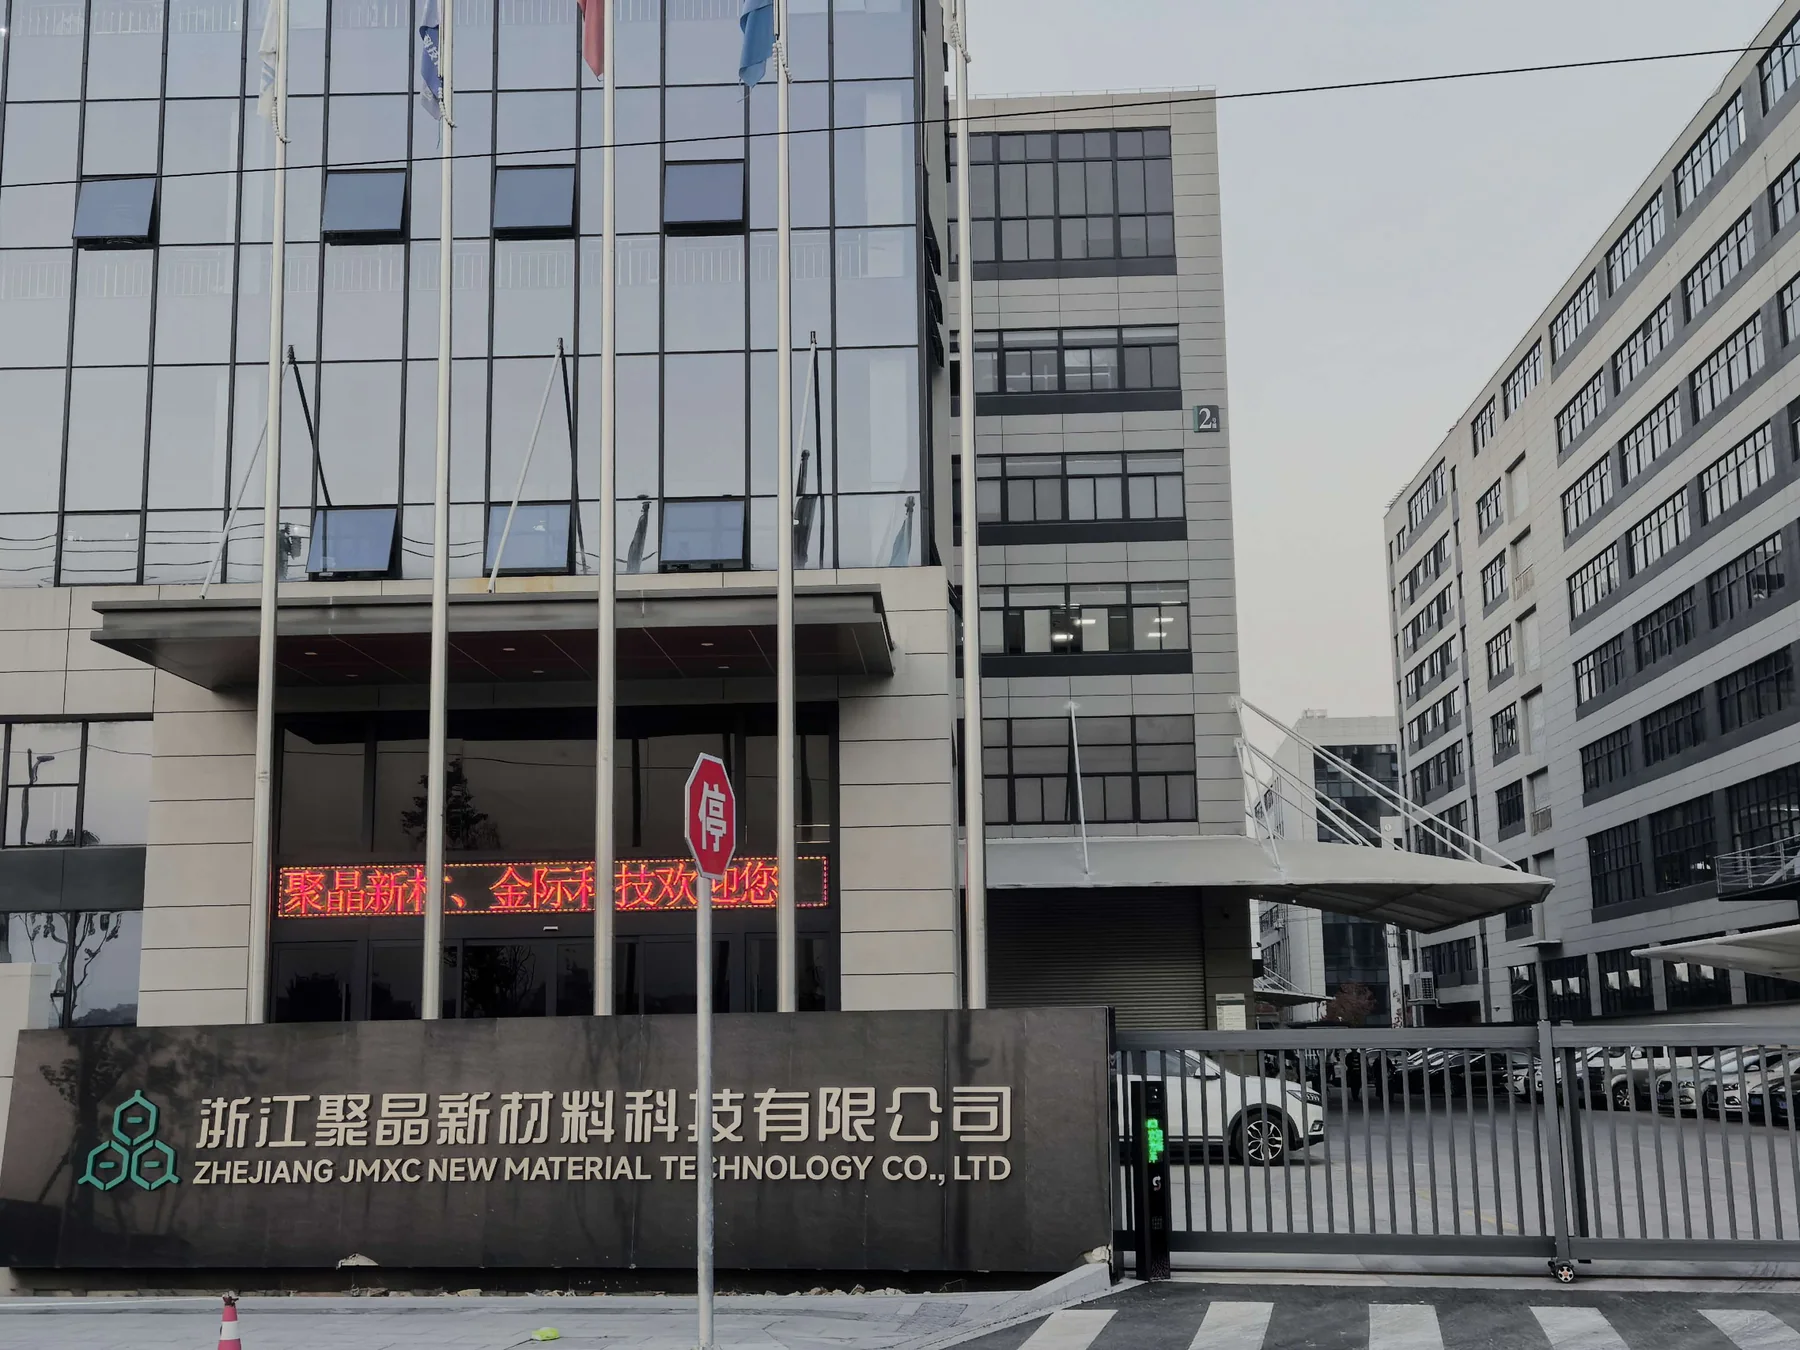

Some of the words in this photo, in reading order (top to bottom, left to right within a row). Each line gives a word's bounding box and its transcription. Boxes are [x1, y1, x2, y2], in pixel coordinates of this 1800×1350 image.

[698, 780, 727, 852] 停
[195, 1086, 1012, 1149] 浙江聚晶新材料科技有限公司
[192, 1160, 334, 1185] ZHEJIANG
[340, 1158, 423, 1183] JMXC
[428, 1157, 498, 1182] NEW
[504, 1155, 651, 1182] MATERIAL
[660, 1154, 874, 1181] TEHNOLOGY
[882, 1154, 946, 1185] CO.,
[953, 1155, 1012, 1181] LTD
